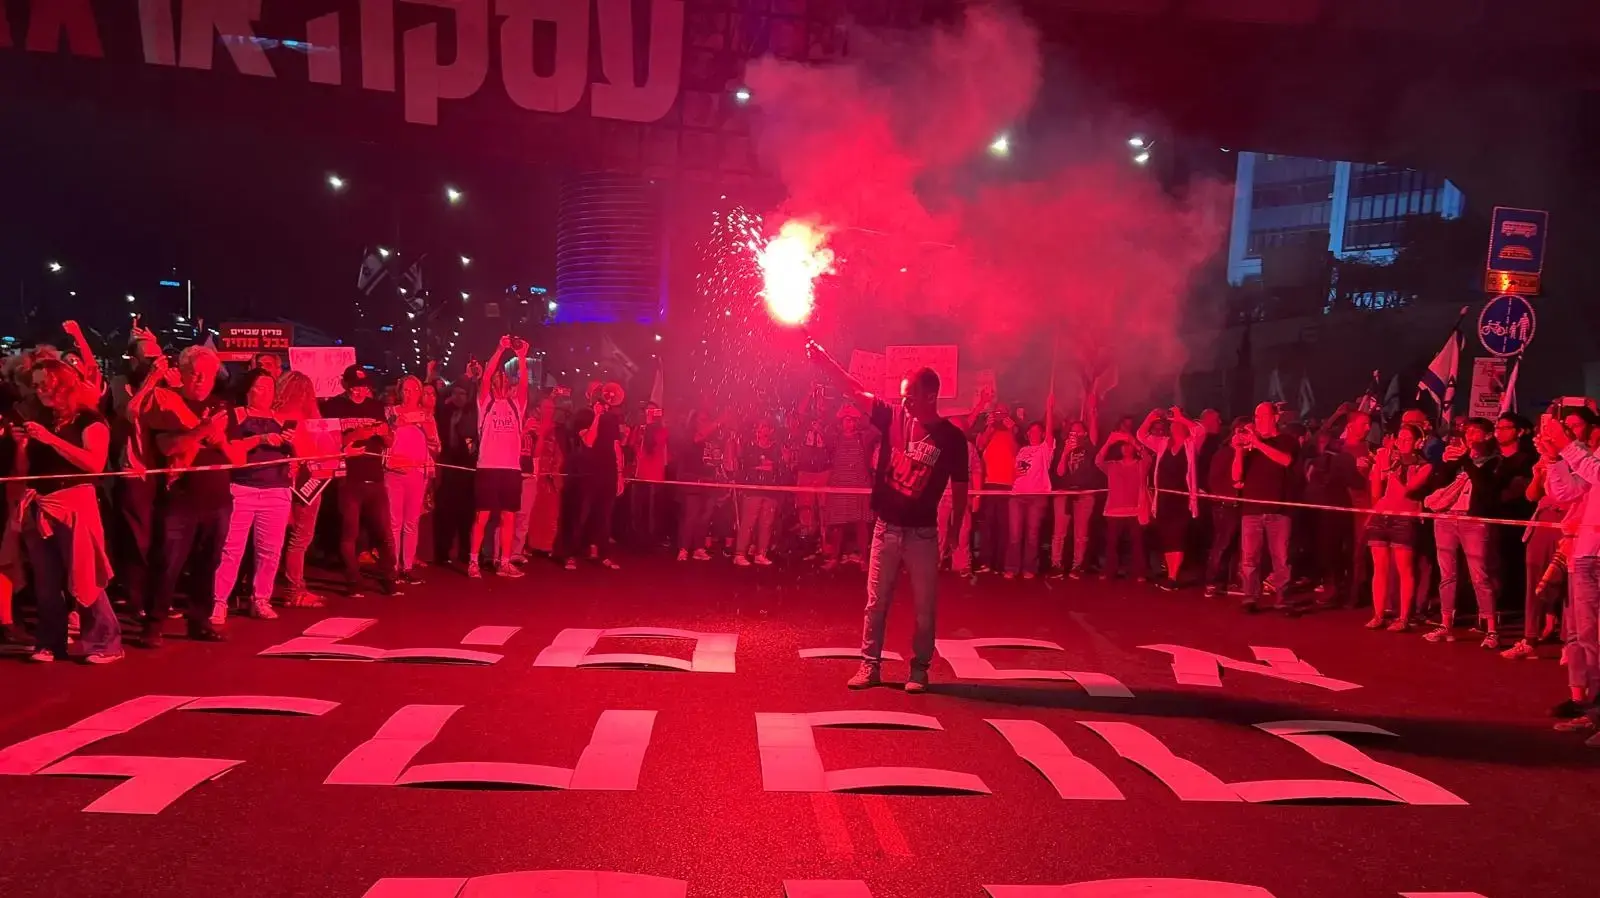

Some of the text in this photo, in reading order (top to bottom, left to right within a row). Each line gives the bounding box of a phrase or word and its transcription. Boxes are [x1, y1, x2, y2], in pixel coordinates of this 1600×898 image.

[261, 328, 282, 337] פדיון
[222, 335, 288, 348] בכל מחיר
